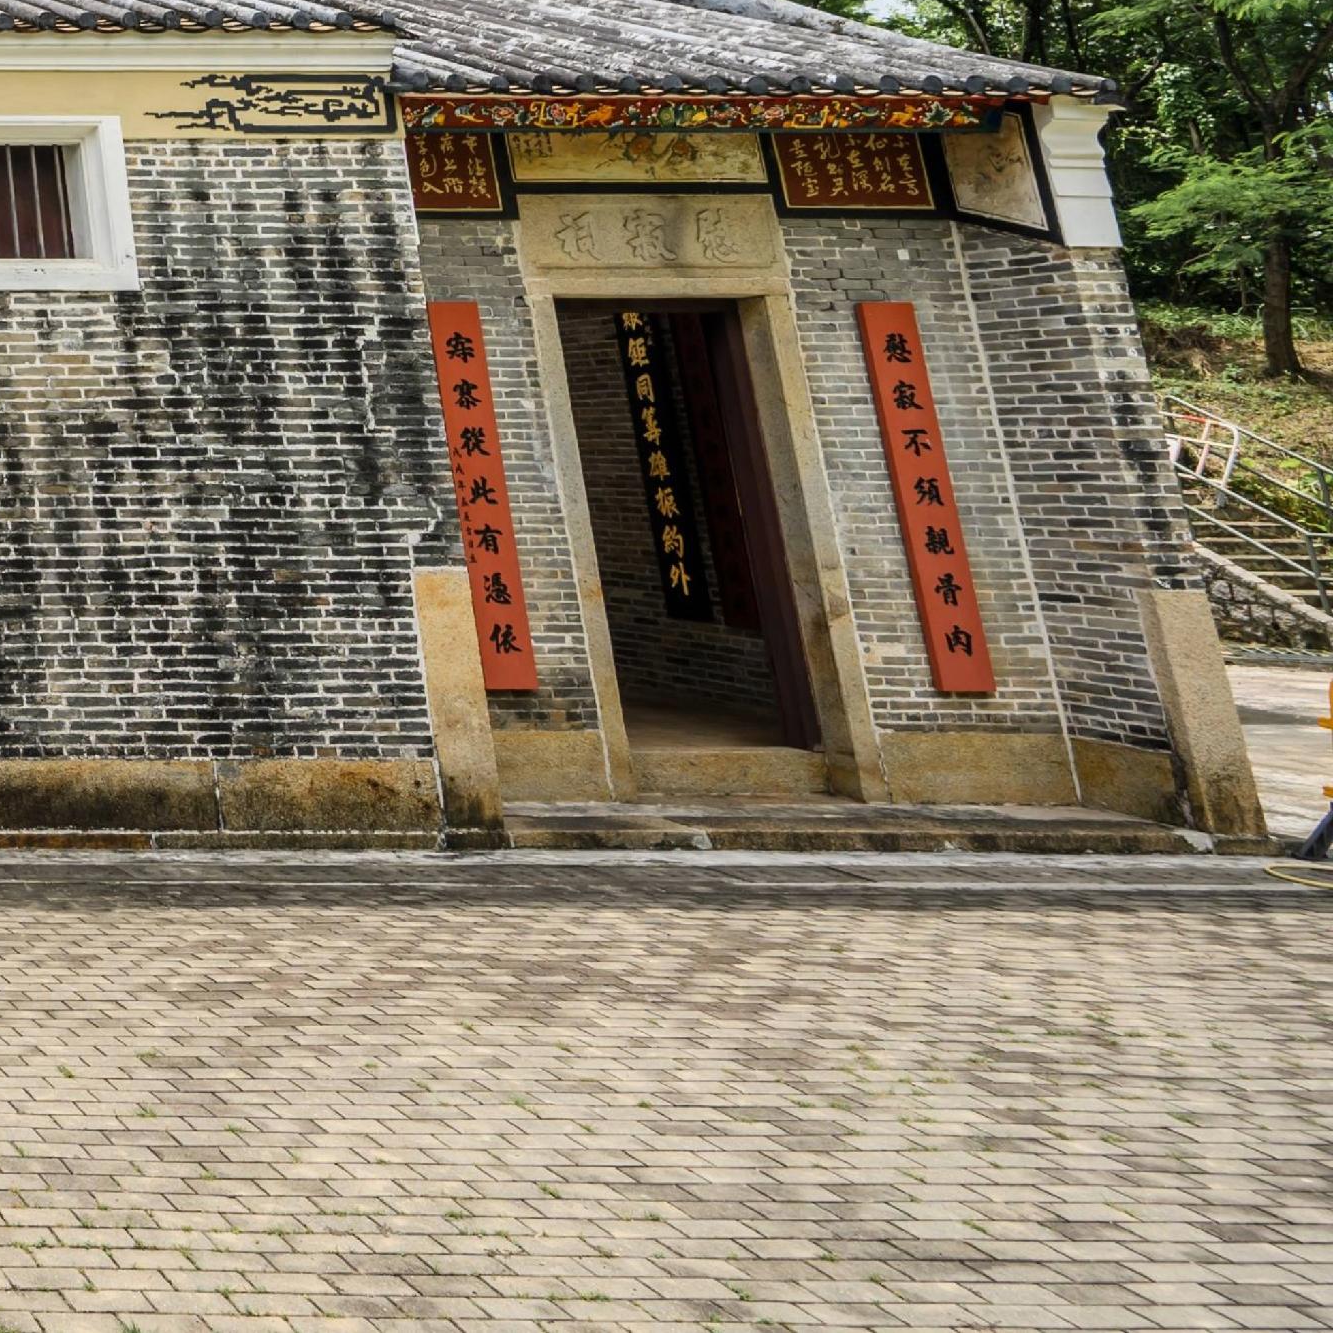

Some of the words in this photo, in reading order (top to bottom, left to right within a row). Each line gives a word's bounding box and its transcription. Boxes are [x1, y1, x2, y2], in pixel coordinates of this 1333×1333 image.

[883, 333, 973, 657] 慰寂不須親骨肉
